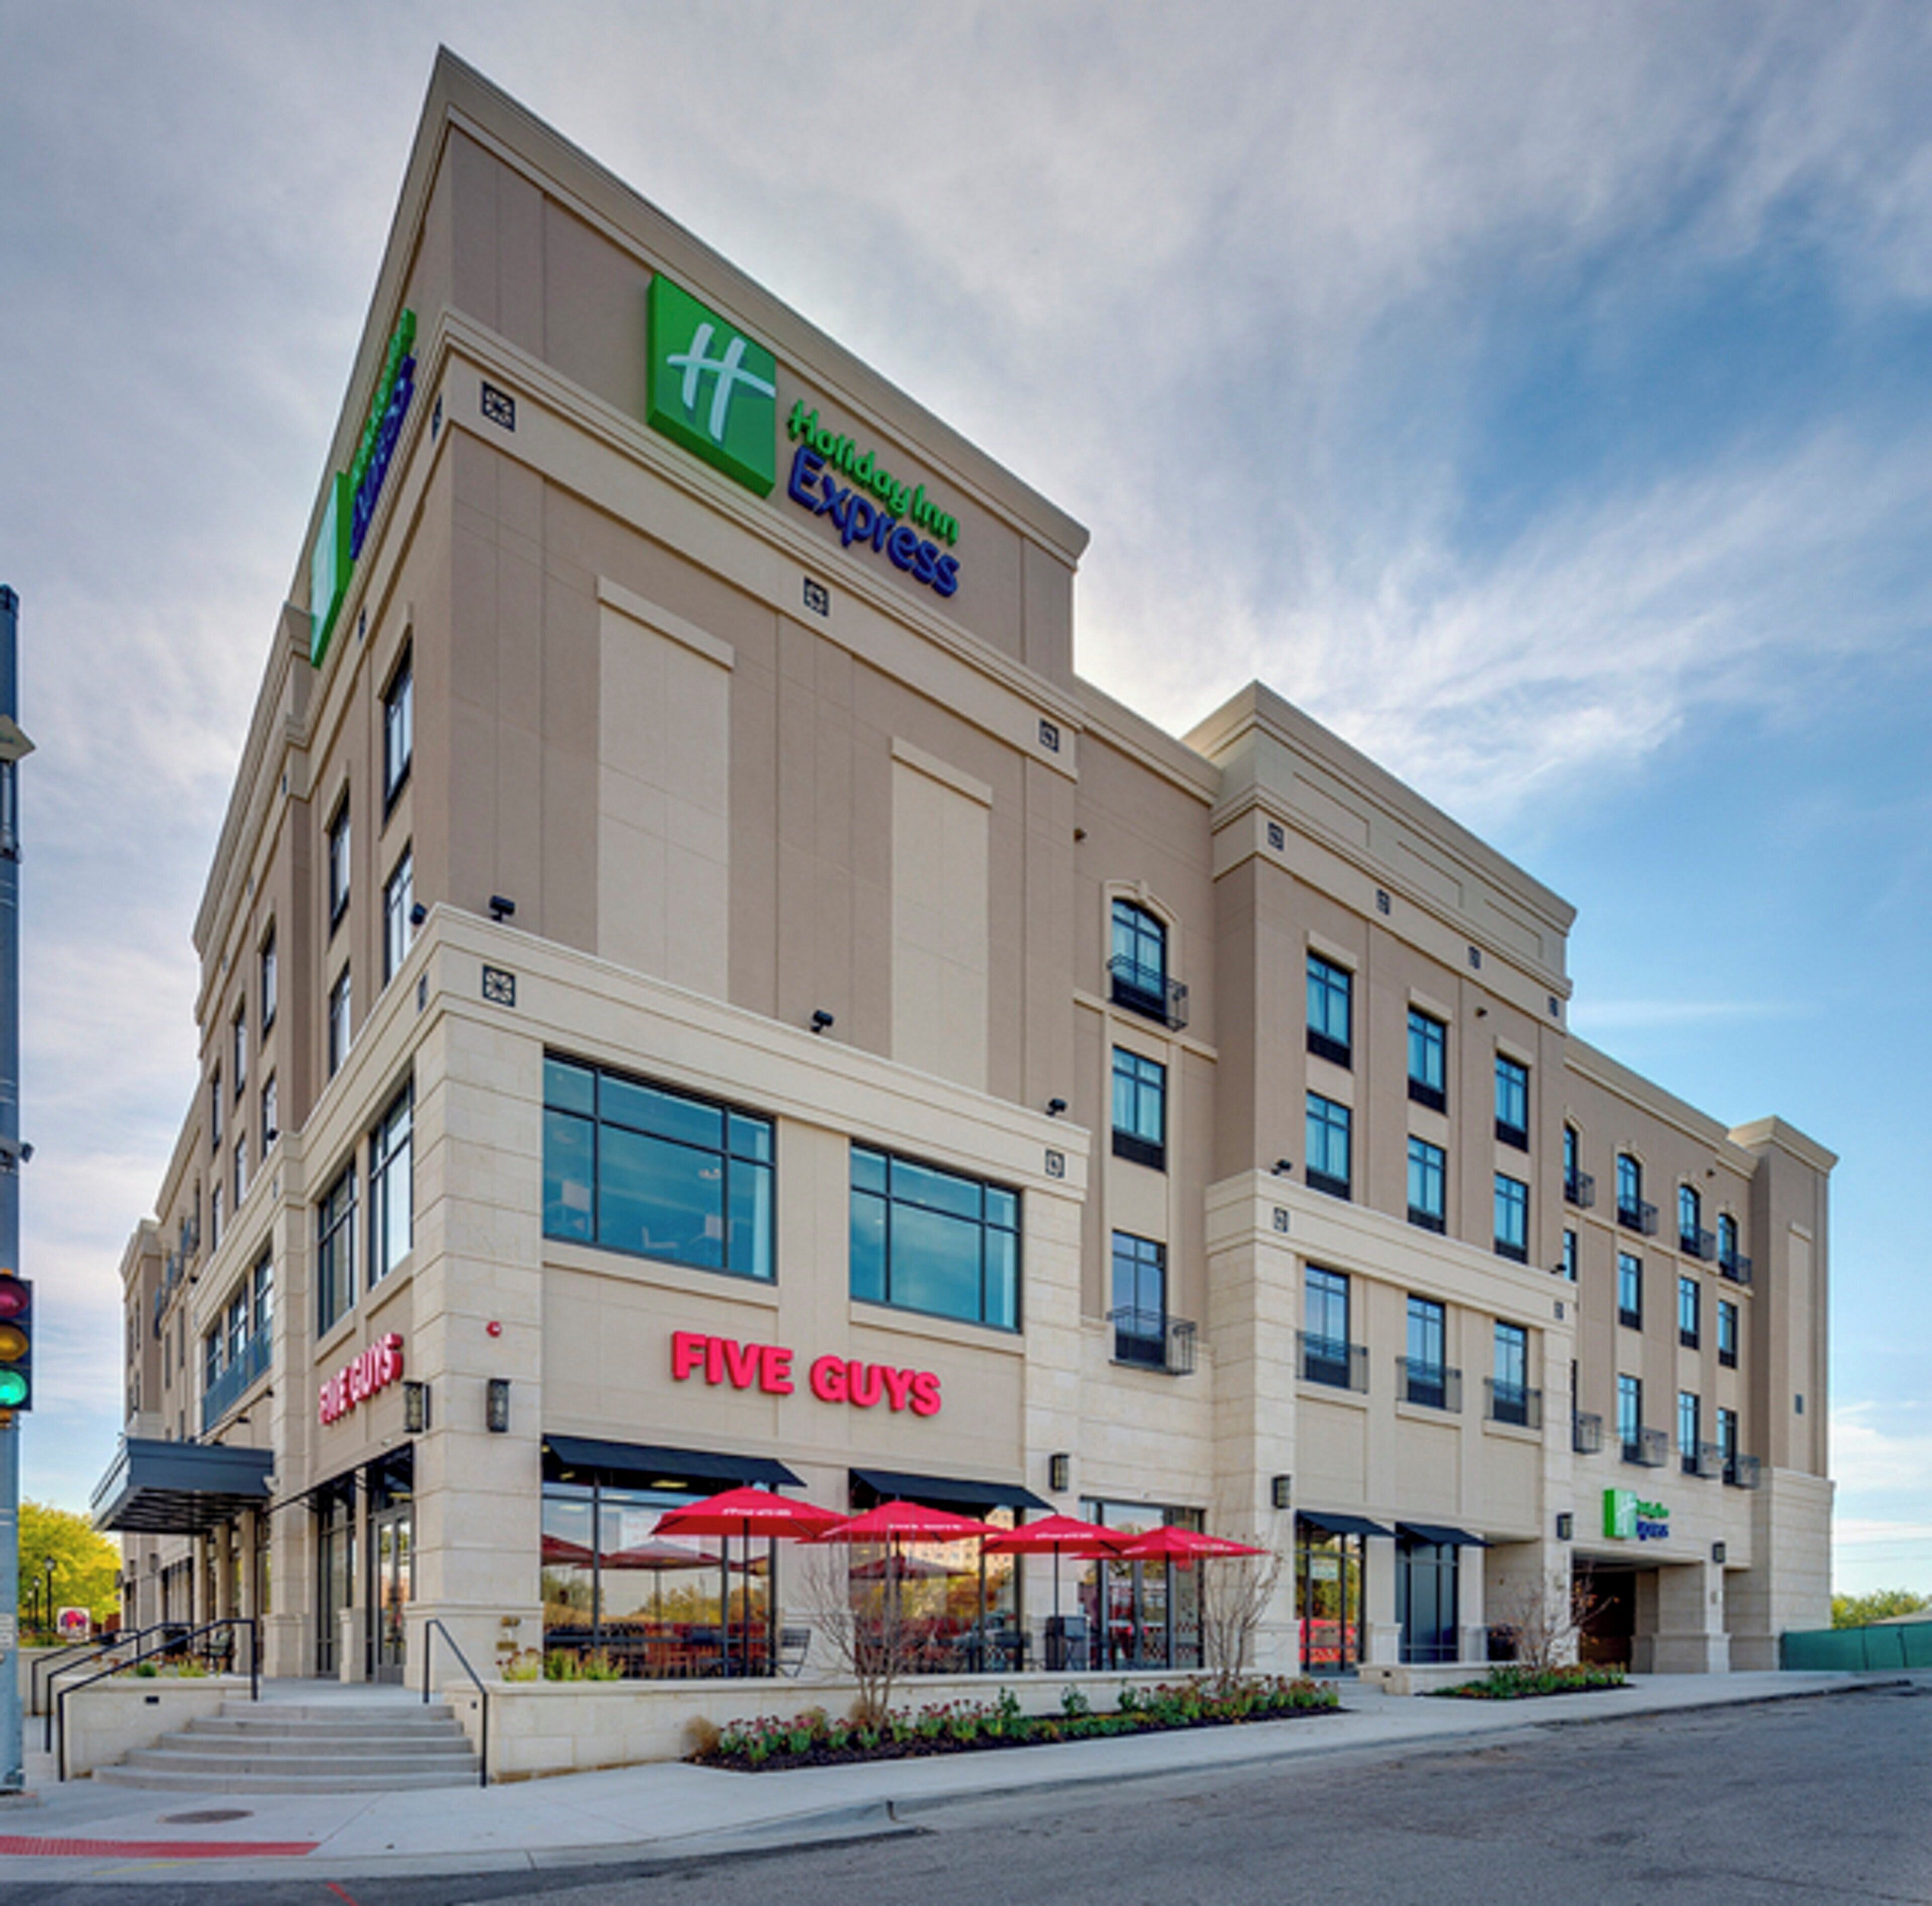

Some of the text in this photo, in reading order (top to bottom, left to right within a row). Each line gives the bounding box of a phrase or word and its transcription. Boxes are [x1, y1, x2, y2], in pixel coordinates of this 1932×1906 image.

[787, 399, 959, 546] Holiday Inn
[788, 445, 959, 597] Express
[673, 1332, 941, 1416] FIVE GUYS
